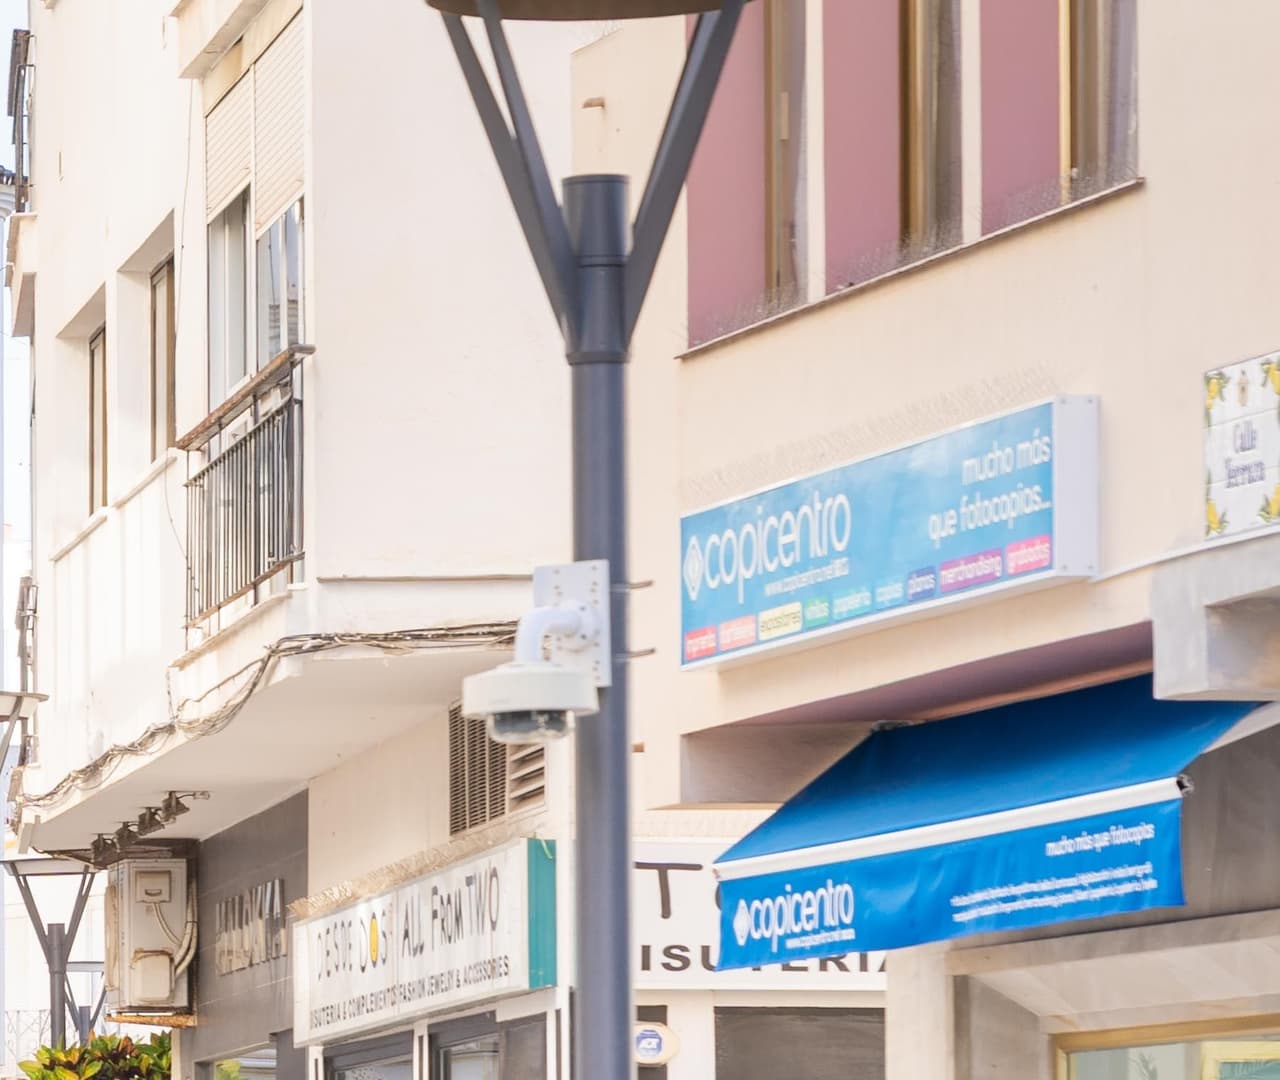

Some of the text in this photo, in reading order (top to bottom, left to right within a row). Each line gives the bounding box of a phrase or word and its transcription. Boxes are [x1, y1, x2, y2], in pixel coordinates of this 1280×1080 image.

[961, 428, 1051, 486] mucho más
[705, 490, 851, 604] copicentro
[929, 509, 956, 549] que
[940, 555, 1002, 586] merchandising
[359, 909, 388, 973] DOS
[402, 893, 425, 959] ALL
[465, 866, 500, 937] TWO
[750, 879, 854, 953] copicentro
